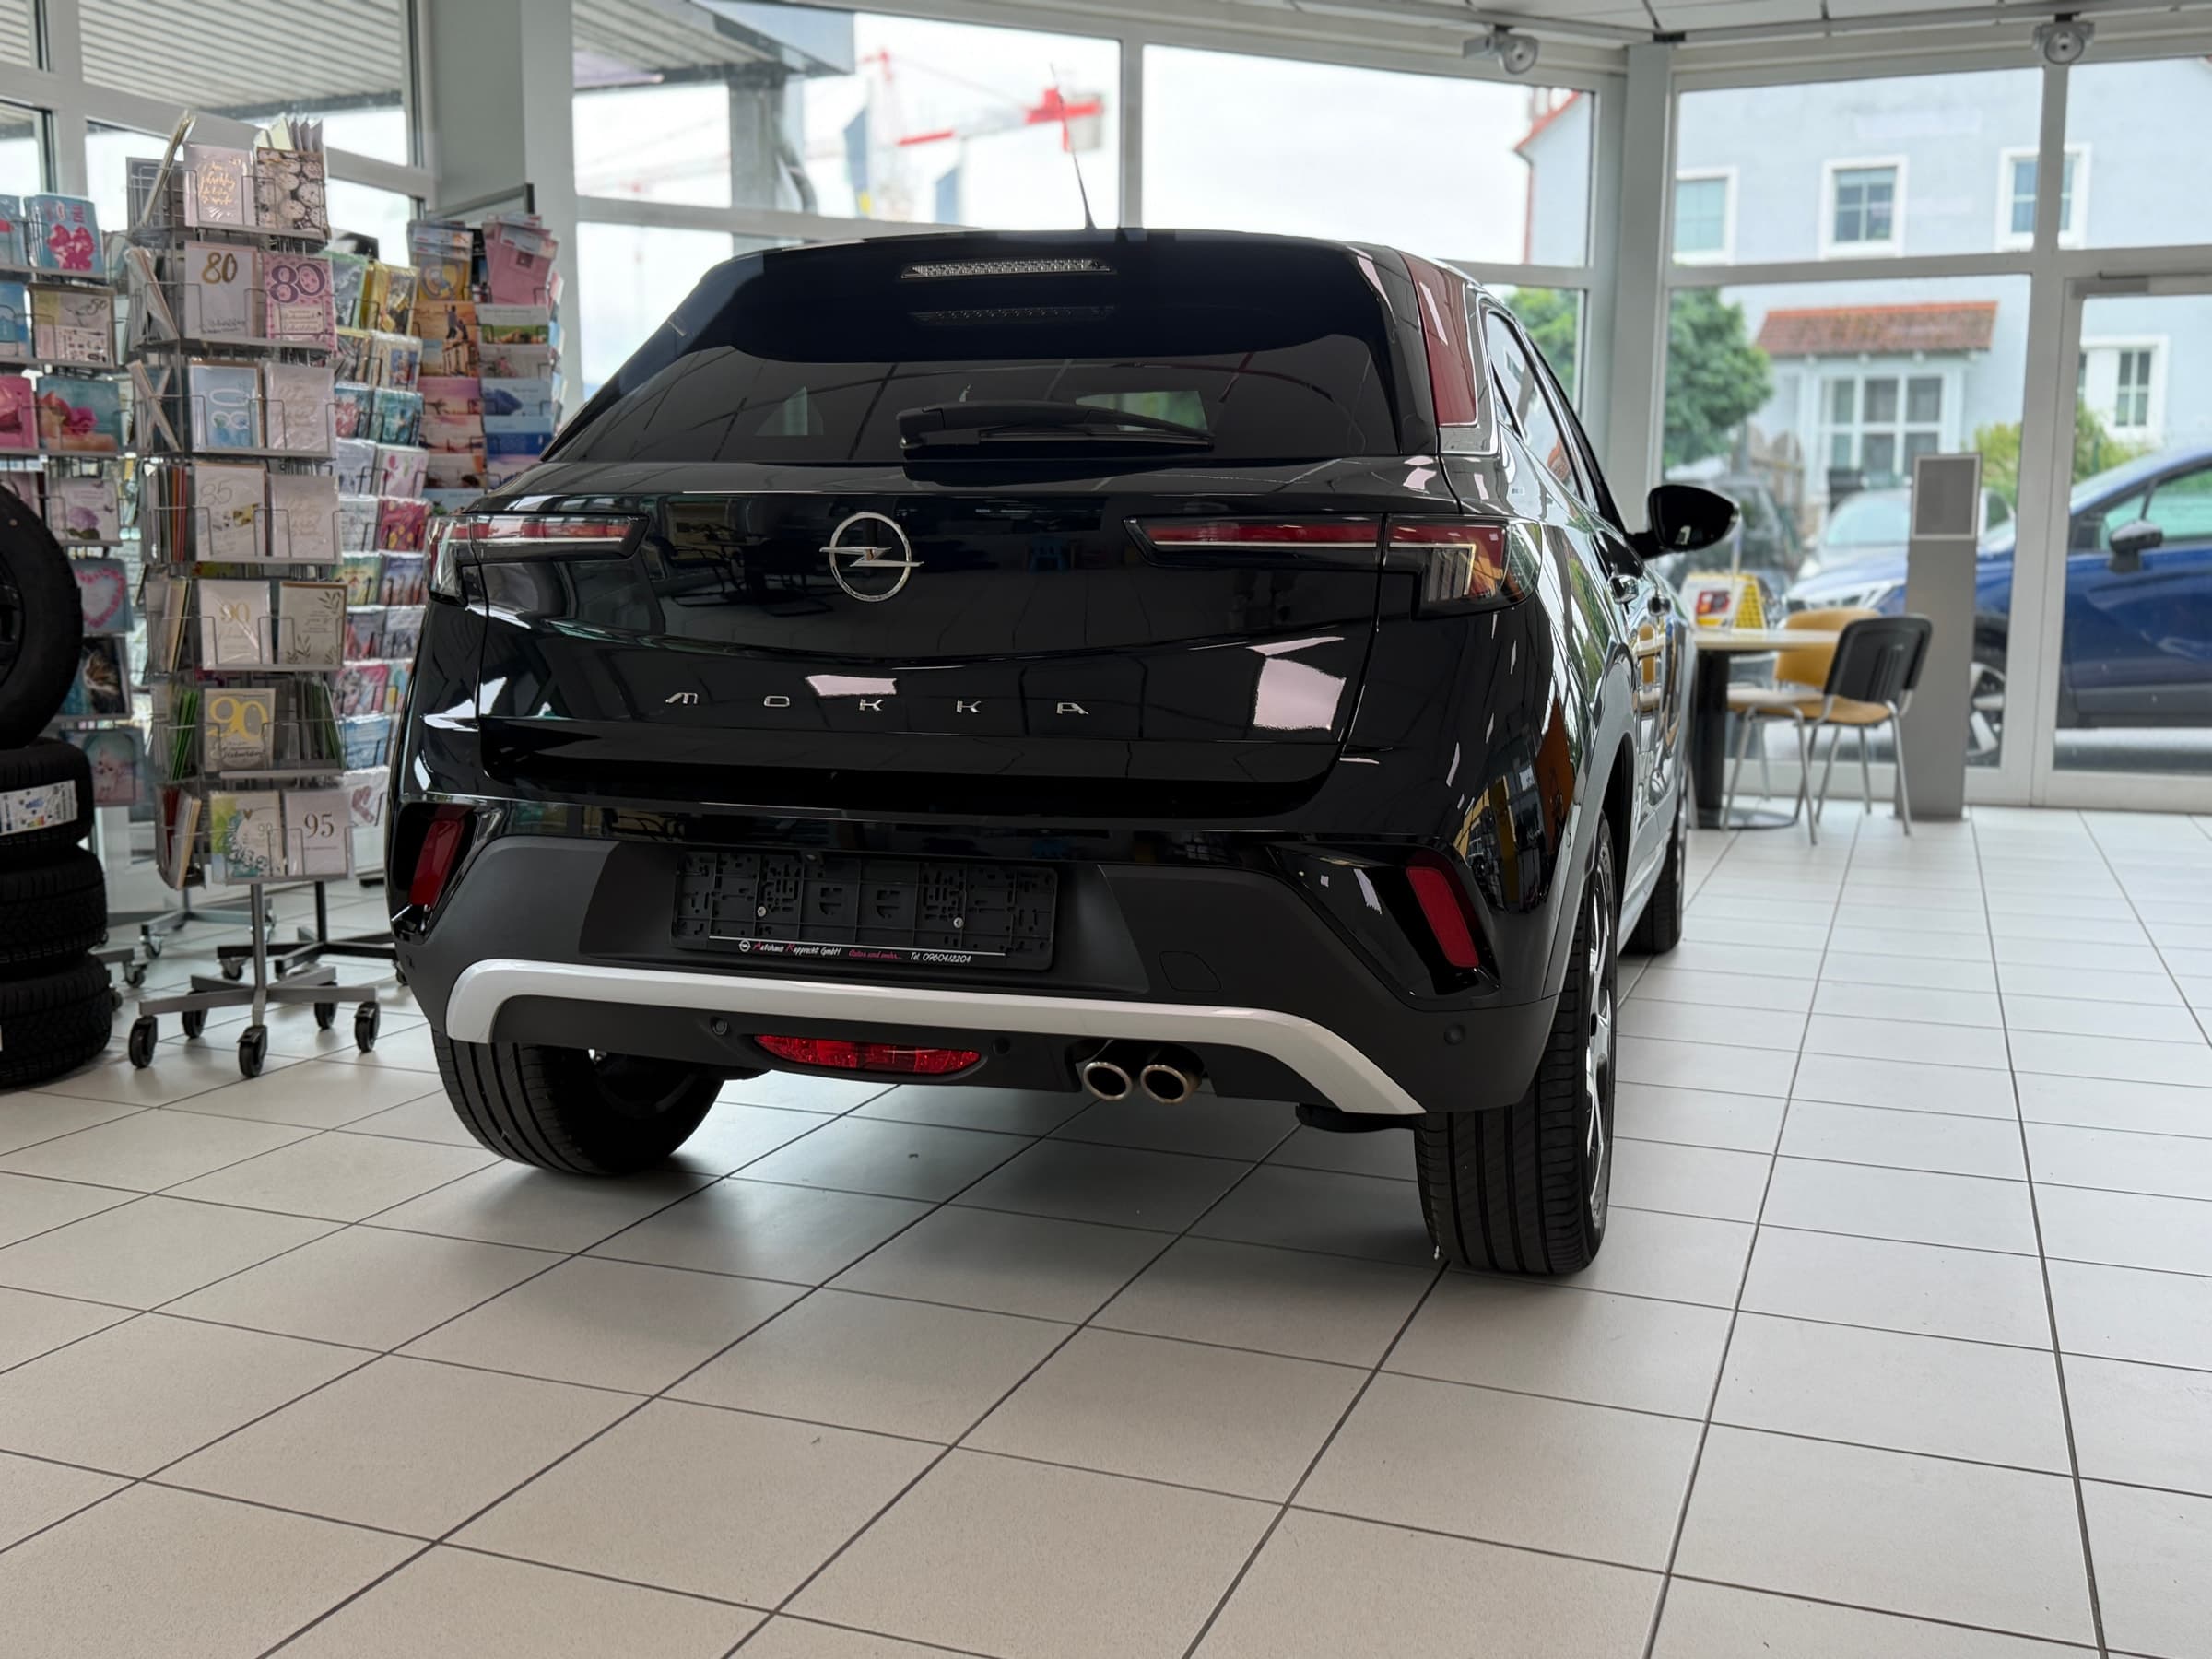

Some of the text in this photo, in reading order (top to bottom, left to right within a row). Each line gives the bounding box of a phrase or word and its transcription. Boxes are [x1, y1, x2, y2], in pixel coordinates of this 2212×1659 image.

[202, 252, 238, 285] 80
[270, 263, 326, 303] 80
[199, 479, 233, 506] 85
[665, 692, 1089, 715] MOKKA
[209, 697, 269, 741] 90
[304, 813, 335, 839] 95
[820, 947, 841, 957] GmbH
